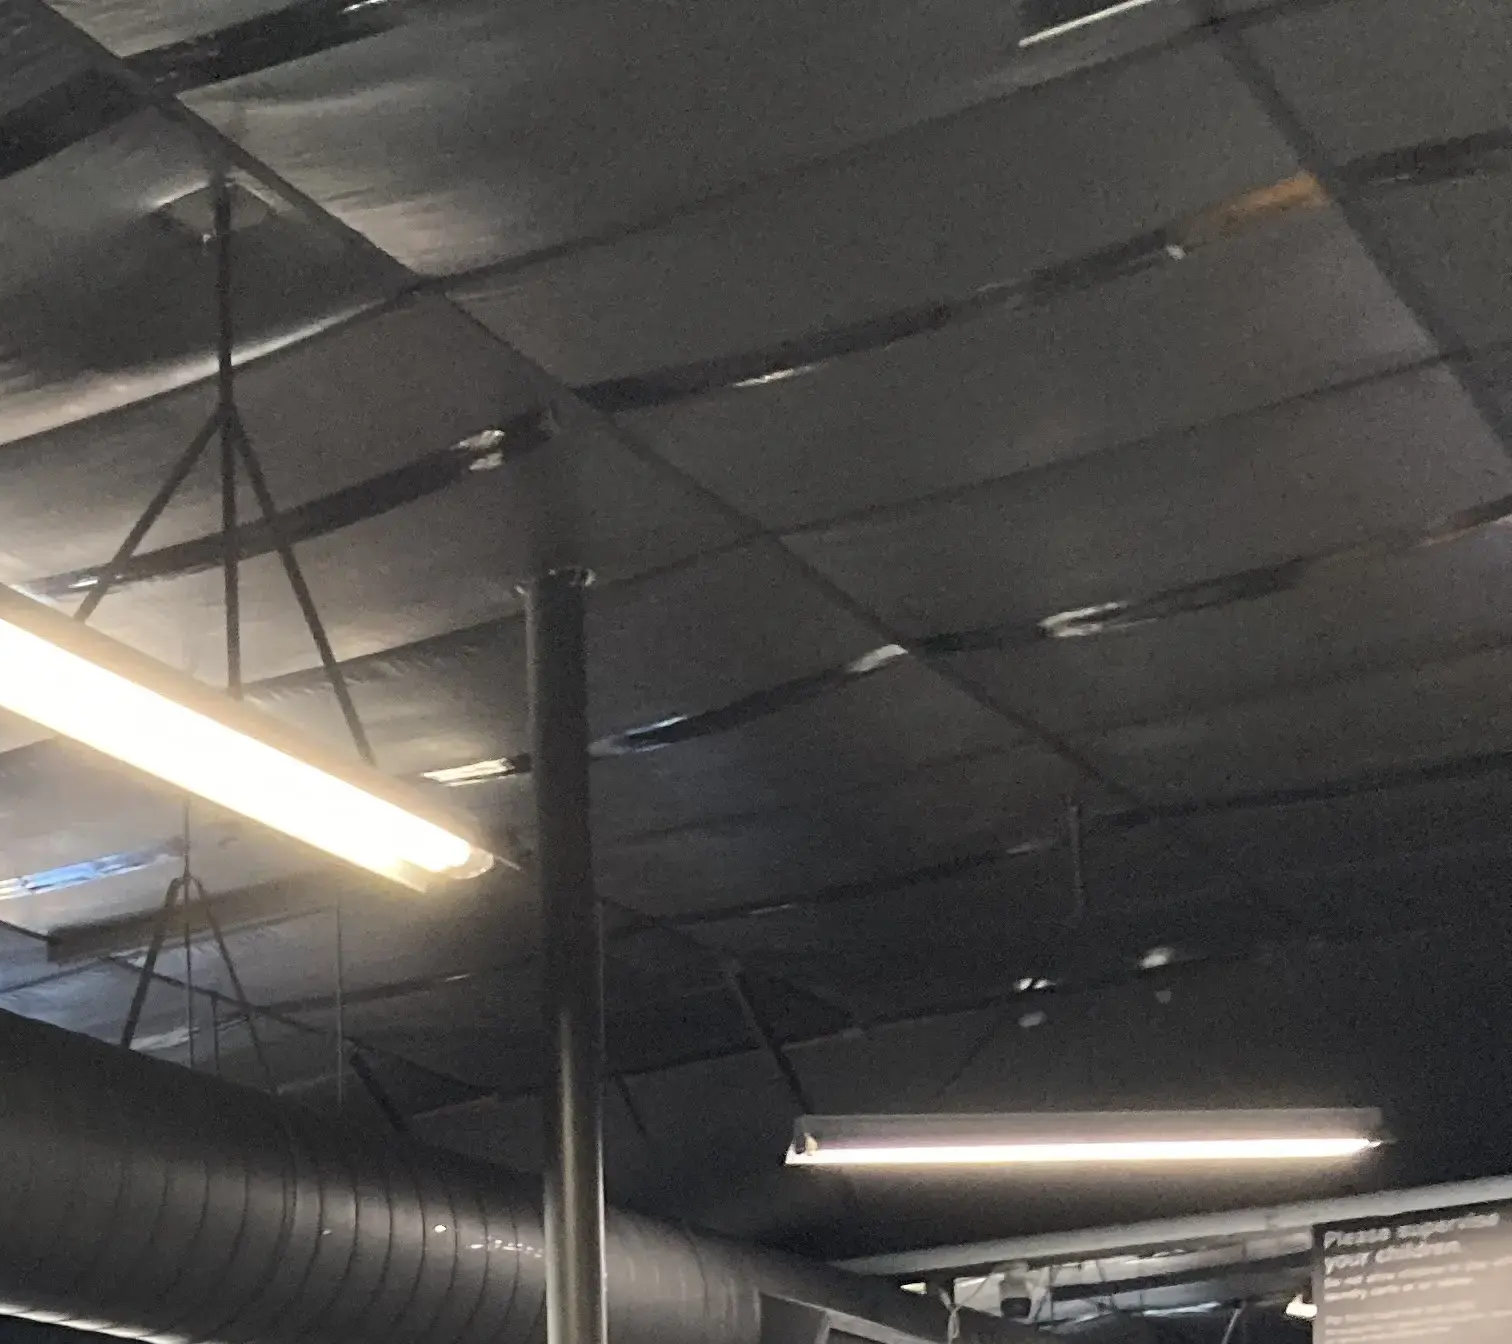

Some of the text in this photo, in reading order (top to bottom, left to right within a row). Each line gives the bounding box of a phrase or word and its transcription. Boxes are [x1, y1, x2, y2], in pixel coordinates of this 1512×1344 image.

[1324, 1212, 1501, 1250] Please supervise
[1324, 1252, 1370, 1275] your
